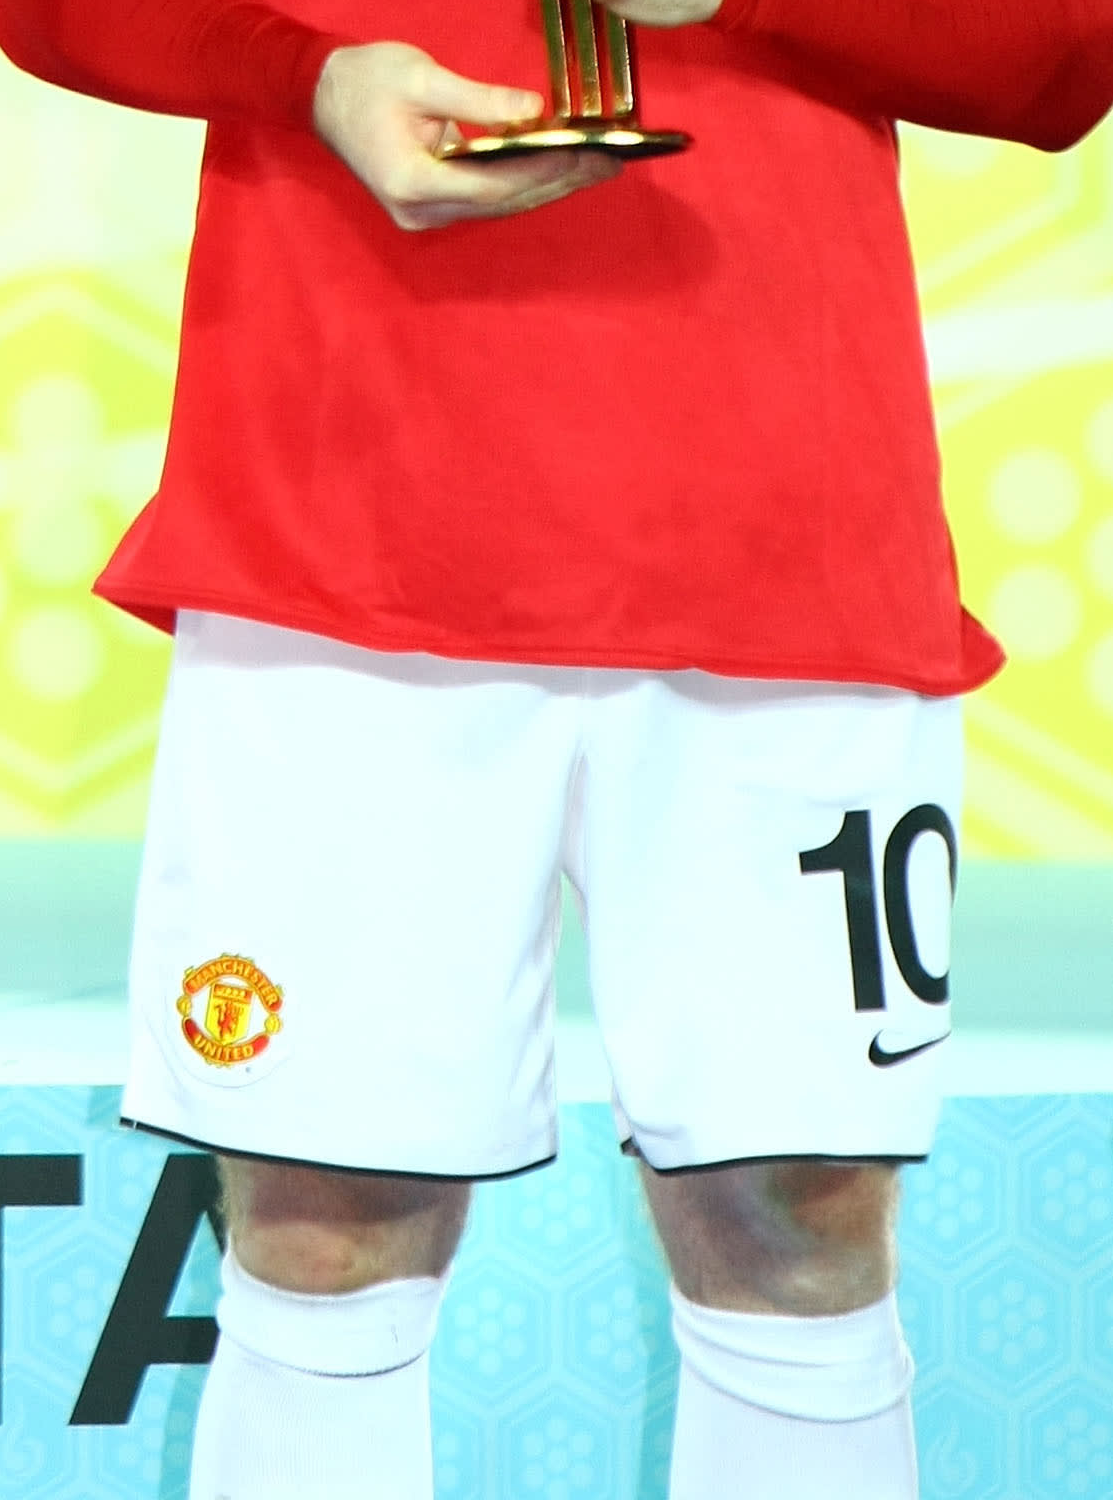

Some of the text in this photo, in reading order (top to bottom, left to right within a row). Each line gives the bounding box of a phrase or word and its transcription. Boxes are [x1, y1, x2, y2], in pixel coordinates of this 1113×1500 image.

[798, 803, 958, 1013] 10
[189, 960, 279, 1007] MANCHESTER
[194, 1034, 255, 1060] UNITED
